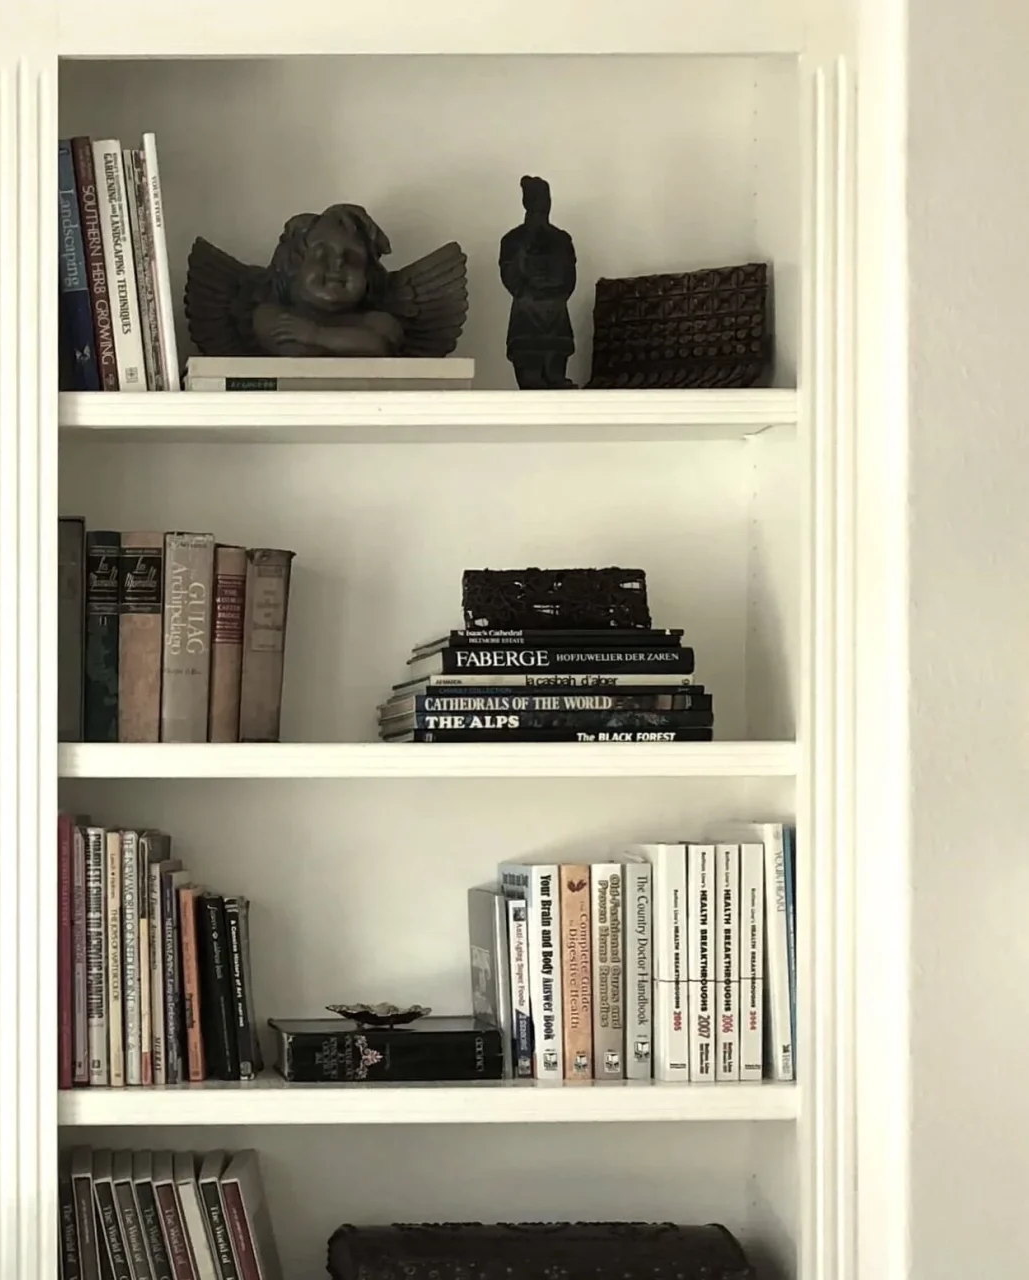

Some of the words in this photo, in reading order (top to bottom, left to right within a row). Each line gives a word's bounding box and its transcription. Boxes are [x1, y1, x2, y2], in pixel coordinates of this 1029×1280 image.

[103, 152, 117, 204] GARDENING
[82, 184, 102, 257] SOUTHERN
[59, 188, 82, 287] Landscaping
[109, 214, 126, 277] LANDSCAPING
[91, 262, 105, 294] HERB
[116, 277, 132, 337] TECHNIQUES
[96, 299, 115, 366] GROWING
[165, 561, 189, 656] Archipelago
[185, 581, 207, 654] GULAG
[488, 629, 524, 637] Cathedral
[455, 650, 551, 668] FABERGE
[556, 653, 624, 662] HOFJUWELIER
[625, 653, 645, 662] DER
[645, 652, 680, 662] ZAREN
[424, 697, 508, 711] CATHEDRALS
[511, 698, 531, 711] OF
[532, 698, 561, 711] THE
[563, 697, 612, 711] WORLD
[425, 715, 465, 729] THE
[467, 714, 520, 729] ALPS
[576, 732, 596, 742] The
[597, 732, 633, 742] BLACK
[635, 732, 677, 742] FOREST
[123, 836, 134, 856] THE
[123, 856, 134, 880] NEW
[774, 851, 784, 878] YOUR
[539, 874, 552, 898] Your
[637, 874, 649, 894] The
[774, 880, 785, 913] HEART
[124, 882, 135, 920] WORLD
[541, 899, 553, 927] Brain
[597, 879, 609, 924] Proven
[699, 889, 708, 926] HEALTH
[723, 889, 732, 925] HEALTH
[85, 916, 104, 929] TO
[111, 909, 119, 923] THE
[609, 873, 621, 964] Old-Fashioned
[635, 894, 649, 936] Country
[230, 926, 239, 953] Concise
[515, 923, 525, 962] Anti-Aging
[541, 928, 553, 948] and
[577, 912, 589, 971] Complete
[598, 925, 609, 964] Home
[232, 953, 241, 978] History
[540, 951, 554, 976] Body
[567, 928, 580, 987] Digestive
[637, 937, 649, 971] Doctor
[516, 963, 525, 984] Super
[699, 928, 708, 1013] BREAKTHROUGHS
[723, 928, 732, 1013] BREAKTHROUGHS
[518, 985, 526, 1006] Foods
[543, 977, 555, 1013] Answer
[580, 975, 590, 1013] Guide
[599, 965, 610, 1029] Remedies
[609, 965, 621, 1004] Cures
[570, 989, 580, 1030] Health
[637, 972, 650, 1026] Handbook
[544, 1014, 556, 1041] Book
[610, 1004, 622, 1031] and
[673, 1010, 681, 1032] 2005
[698, 1014, 711, 1039] 2007
[721, 1013, 733, 1034] 2006
[62, 1204, 73, 1225] The
[103, 1205, 115, 1226] The
[123, 1207, 136, 1227] The
[143, 1207, 156, 1227] The
[163, 1207, 176, 1226] The
[209, 1205, 222, 1225] The
[64, 1225, 75, 1254] World
[106, 1226, 121, 1253] World
[127, 1227, 141, 1254] World
[147, 1227, 162, 1255] World
[168, 1227, 184, 1255] World
[212, 1225, 228, 1253] World
[67, 1254, 76, 1264] of
[112, 1253, 124, 1264] of
[133, 1254, 144, 1264] of
[153, 1254, 165, 1264] of
[175, 1254, 187, 1266] of
[220, 1253, 232, 1264] of
